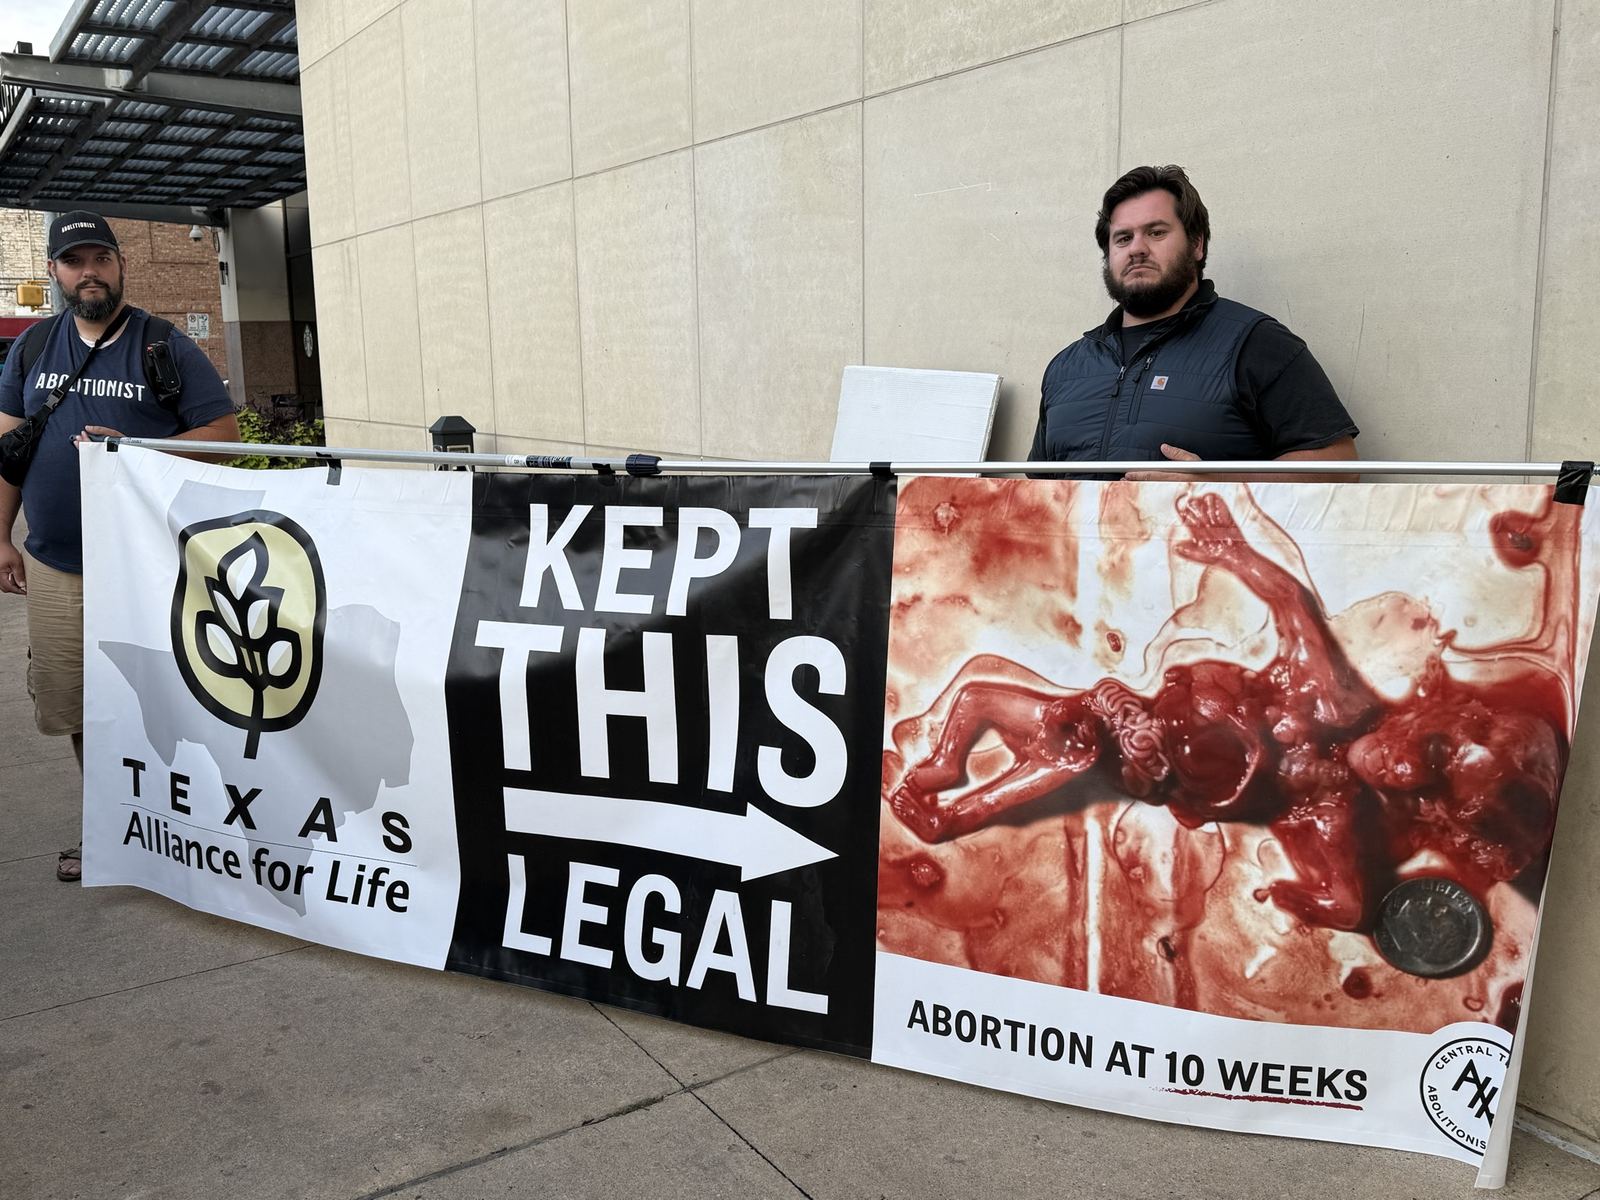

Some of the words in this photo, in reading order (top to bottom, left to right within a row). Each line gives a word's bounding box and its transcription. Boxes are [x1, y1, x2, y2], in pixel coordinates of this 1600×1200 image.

[518, 503, 819, 620] KEPT
[474, 619, 848, 808] THIS
[122, 757, 413, 855] TEXAS
[122, 811, 242, 880] Alliance
[252, 847, 314, 896] for
[325, 860, 411, 914] Life
[501, 853, 829, 1015] LEGAL
[906, 999, 1094, 1068] ABORTION
[1105, 1040, 1155, 1079] AT
[1164, 1050, 1205, 1087] 10
[1217, 1057, 1368, 1102] WEEKS
[1435, 1045, 1493, 1070] CENTRAL
